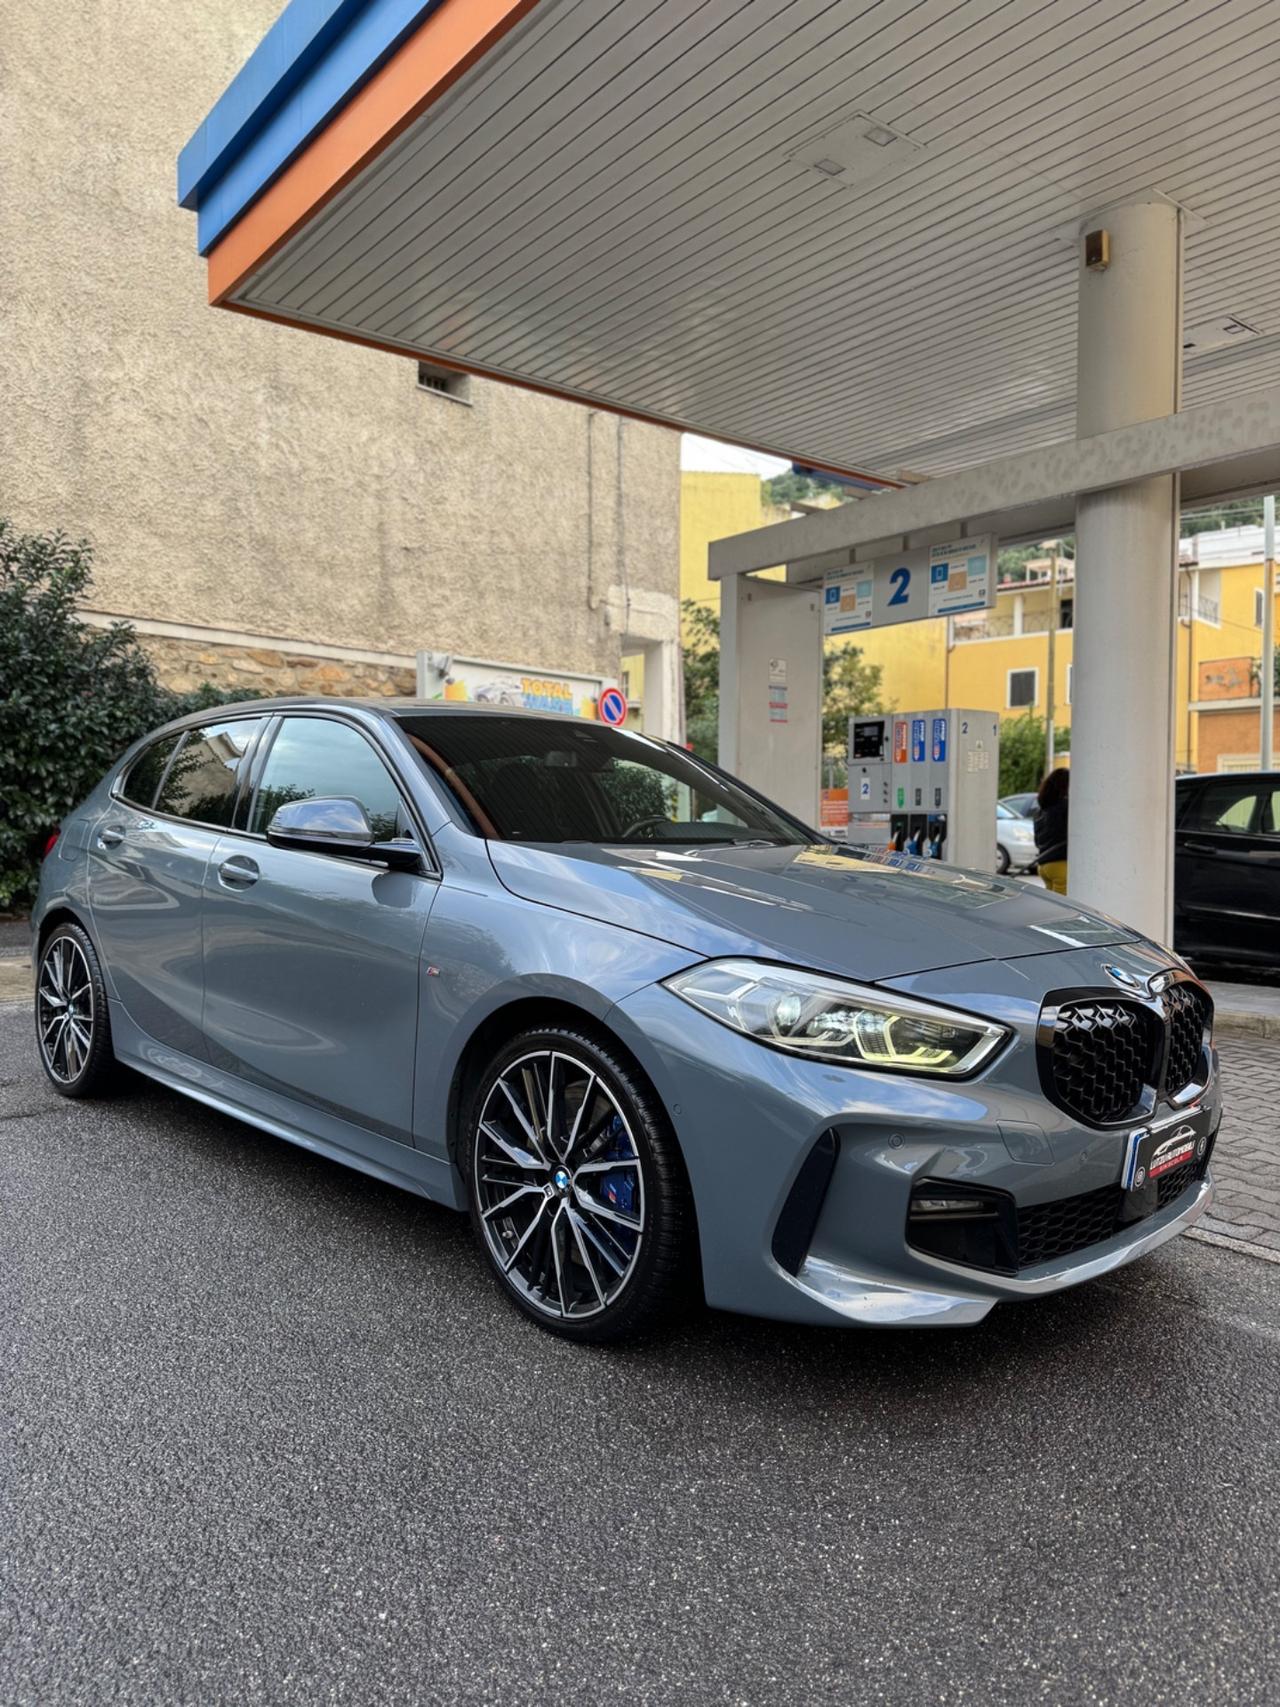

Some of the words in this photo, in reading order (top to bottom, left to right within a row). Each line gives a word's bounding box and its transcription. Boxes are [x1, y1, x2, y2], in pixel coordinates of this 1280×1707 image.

[887, 567, 911, 607] 2
[521, 677, 573, 700] TOTAL
[962, 722, 968, 734] 2
[862, 783, 869, 794] 2
